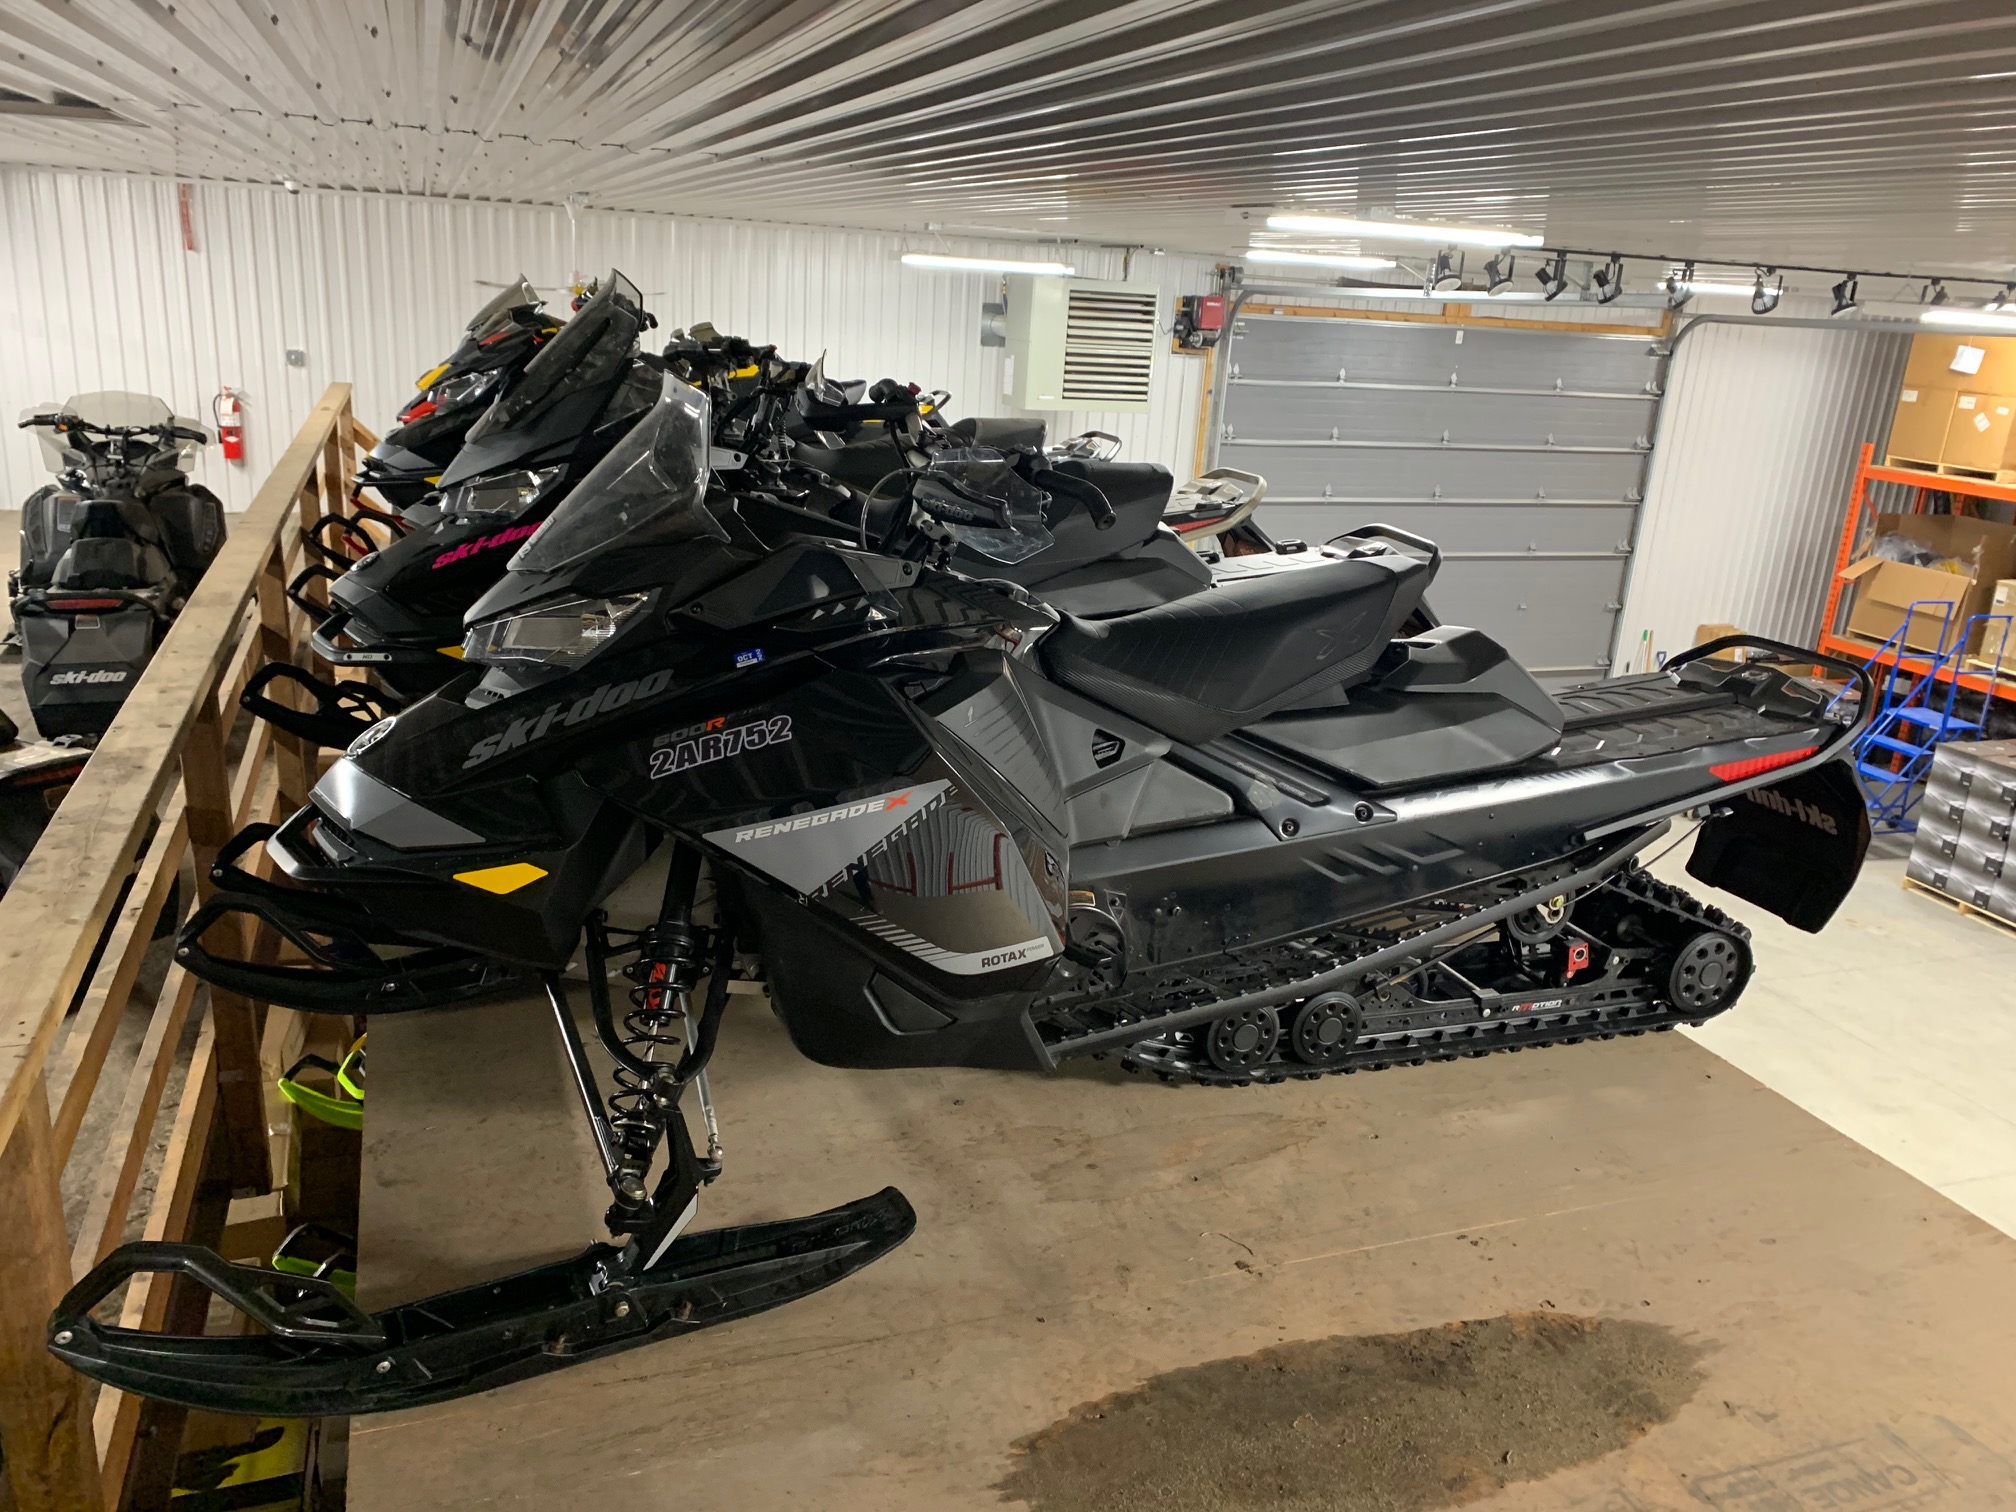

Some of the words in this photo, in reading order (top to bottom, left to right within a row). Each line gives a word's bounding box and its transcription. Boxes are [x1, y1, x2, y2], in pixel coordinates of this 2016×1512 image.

[736, 652, 753, 663] OCT
[49, 669, 128, 686] ski-doo
[461, 668, 675, 771] ski-doo
[649, 714, 793, 780] 2AR752
[981, 948, 1028, 968] ROTAX
